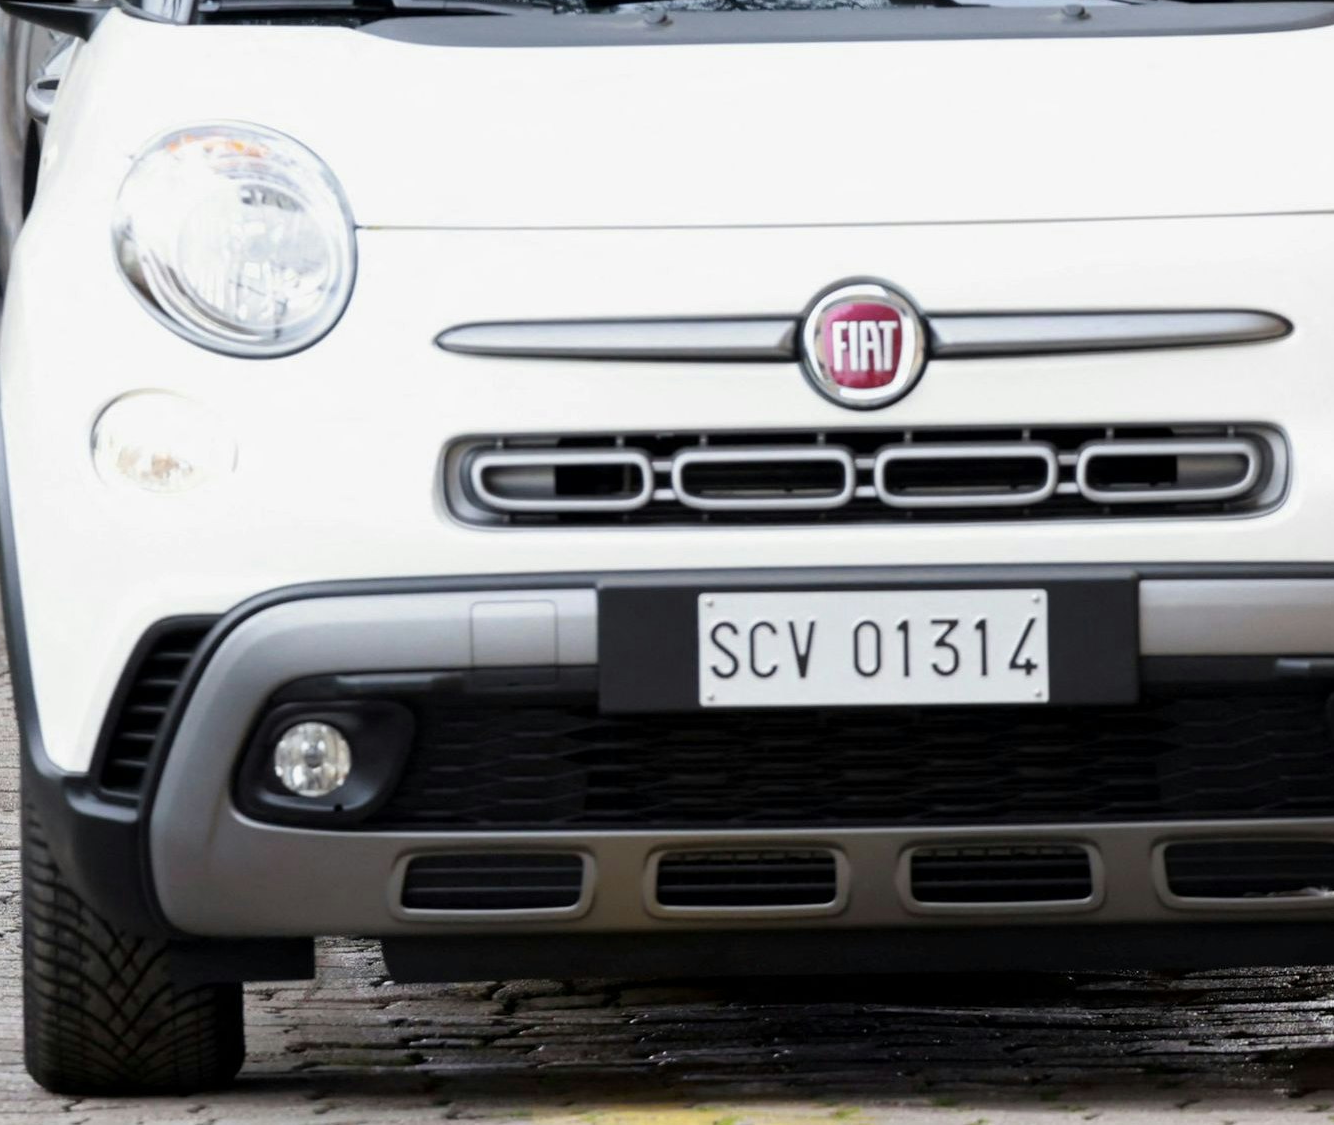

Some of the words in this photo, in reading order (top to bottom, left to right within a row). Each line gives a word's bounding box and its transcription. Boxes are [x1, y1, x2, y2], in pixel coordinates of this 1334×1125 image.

[831, 320, 898, 372] FIAT
[709, 619, 816, 679] SCV
[852, 618, 1039, 678] 01314
